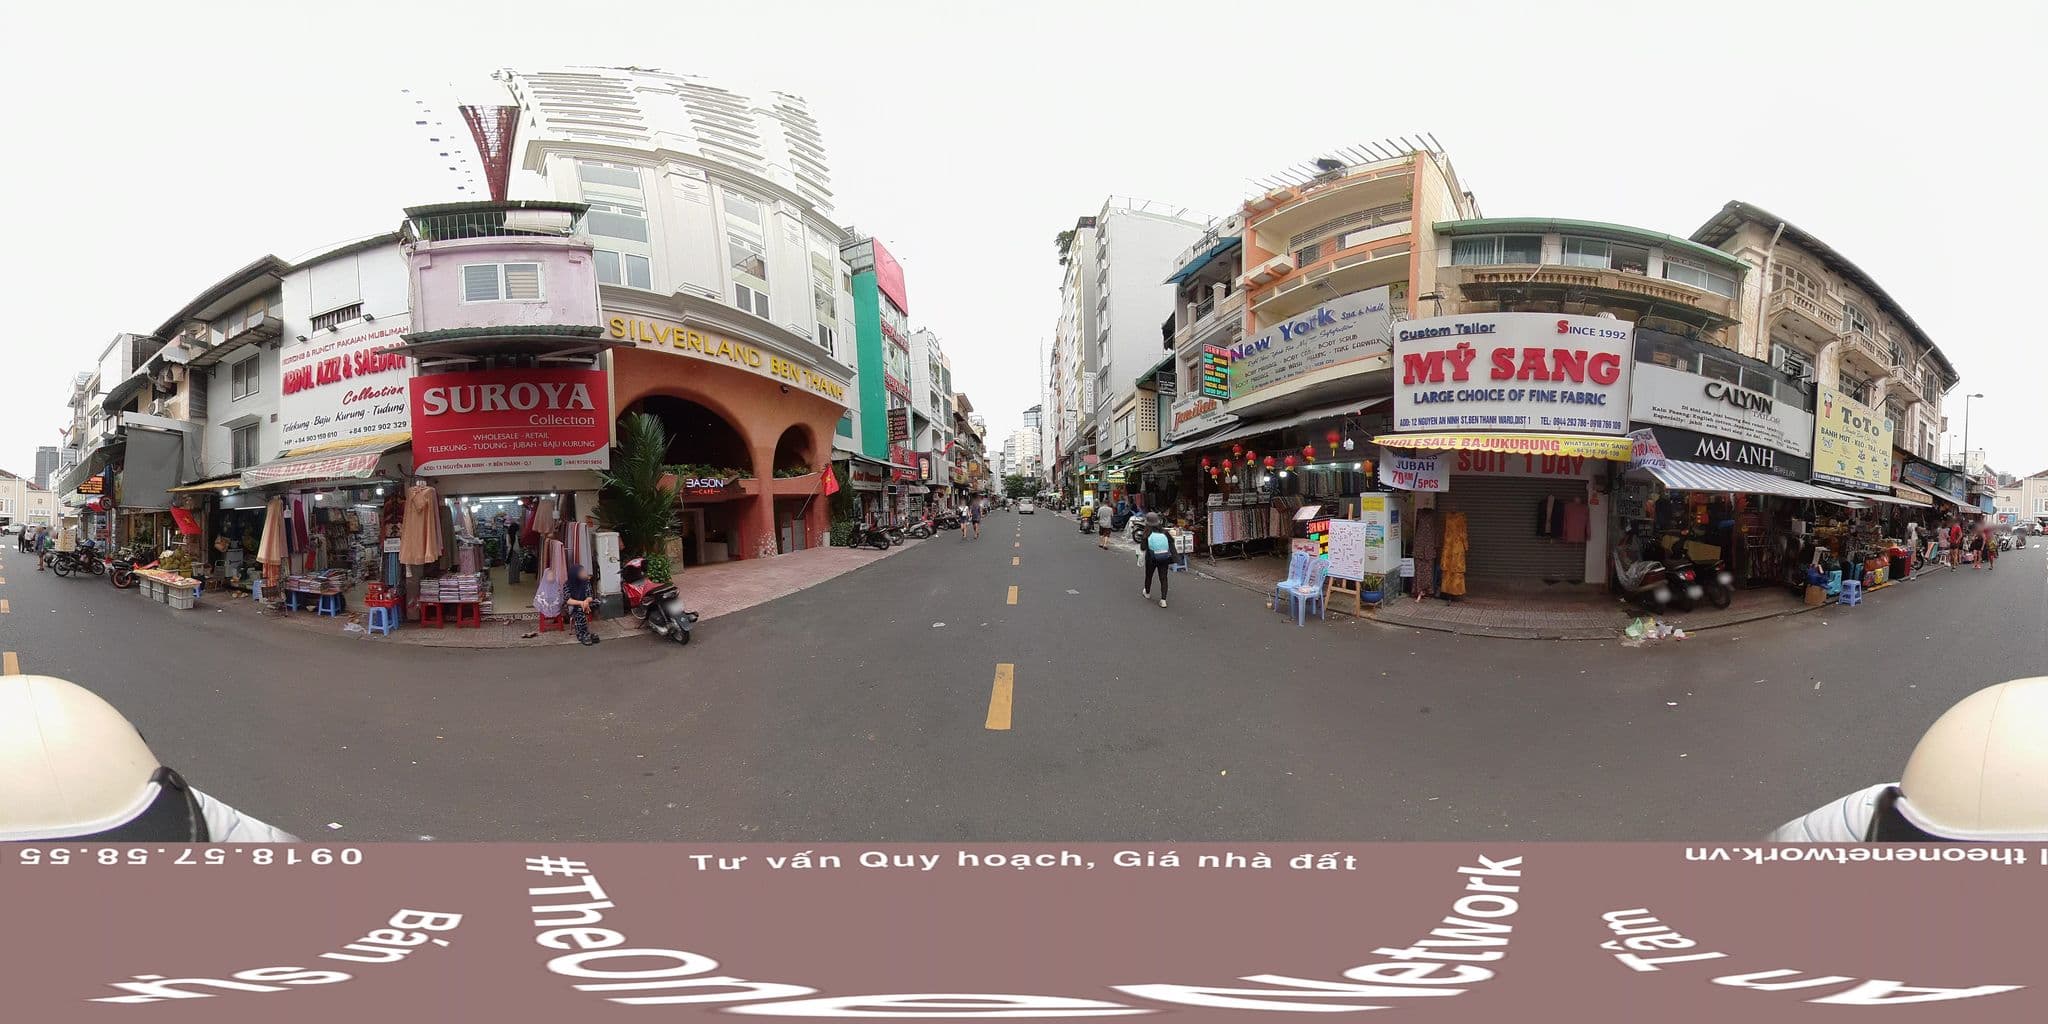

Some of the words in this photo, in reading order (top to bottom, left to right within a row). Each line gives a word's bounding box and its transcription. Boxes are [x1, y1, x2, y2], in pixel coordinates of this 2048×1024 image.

[1230, 336, 1272, 362] New
[1278, 306, 1337, 342] York
[1365, 303, 1384, 313] Nail
[1399, 327, 1450, 340] Custom
[1455, 322, 1495, 334] Tailor
[1599, 329, 1627, 340] 1992
[336, 334, 367, 349] PAKAIAN
[609, 316, 761, 367] SILVERLAND
[770, 355, 801, 383] BEN
[803, 370, 844, 401] THANH
[1403, 342, 1476, 385] MỸ
[1491, 347, 1620, 386] SANG
[316, 356, 342, 386] AZIZ
[342, 353, 352, 379] &
[342, 386, 404, 406] Collection
[423, 382, 596, 416] SUROYA
[1413, 390, 1455, 405] LARGE
[1457, 388, 1505, 402] CHOICE
[1508, 389, 1525, 401] OF
[1528, 389, 1557, 403] FINE
[1560, 390, 1606, 406] FABRIC
[1704, 382, 1773, 415] CALYNN
[335, 408, 365, 422] Kurung
[373, 402, 405, 415] Tudung
[529, 414, 595, 425] Collection
[1411, 418, 1417, 426] 12
[1418, 416, 1437, 425] NGUYEN
[1438, 416, 1446, 425] AN
[1447, 415, 1459, 424] NINH
[1480, 415, 1497, 424] THANH
[428, 443, 467, 453] TELEKUNG
[473, 442, 507, 450] TUDUNG
[513, 441, 537, 450] JUBAH
[543, 440, 560, 449] BAJU
[562, 440, 595, 448] KURUNG
[473, 433, 519, 441] WHOLESALE
[1378, 437, 1456, 447] WHOLESALE
[1461, 437, 1560, 451] BAJUKURUNG
[1395, 460, 1435, 471] JUBAH
[1457, 449, 1505, 473] SUIT
[1541, 454, 1584, 476] DAY
[1736, 444, 1774, 468] ANH
